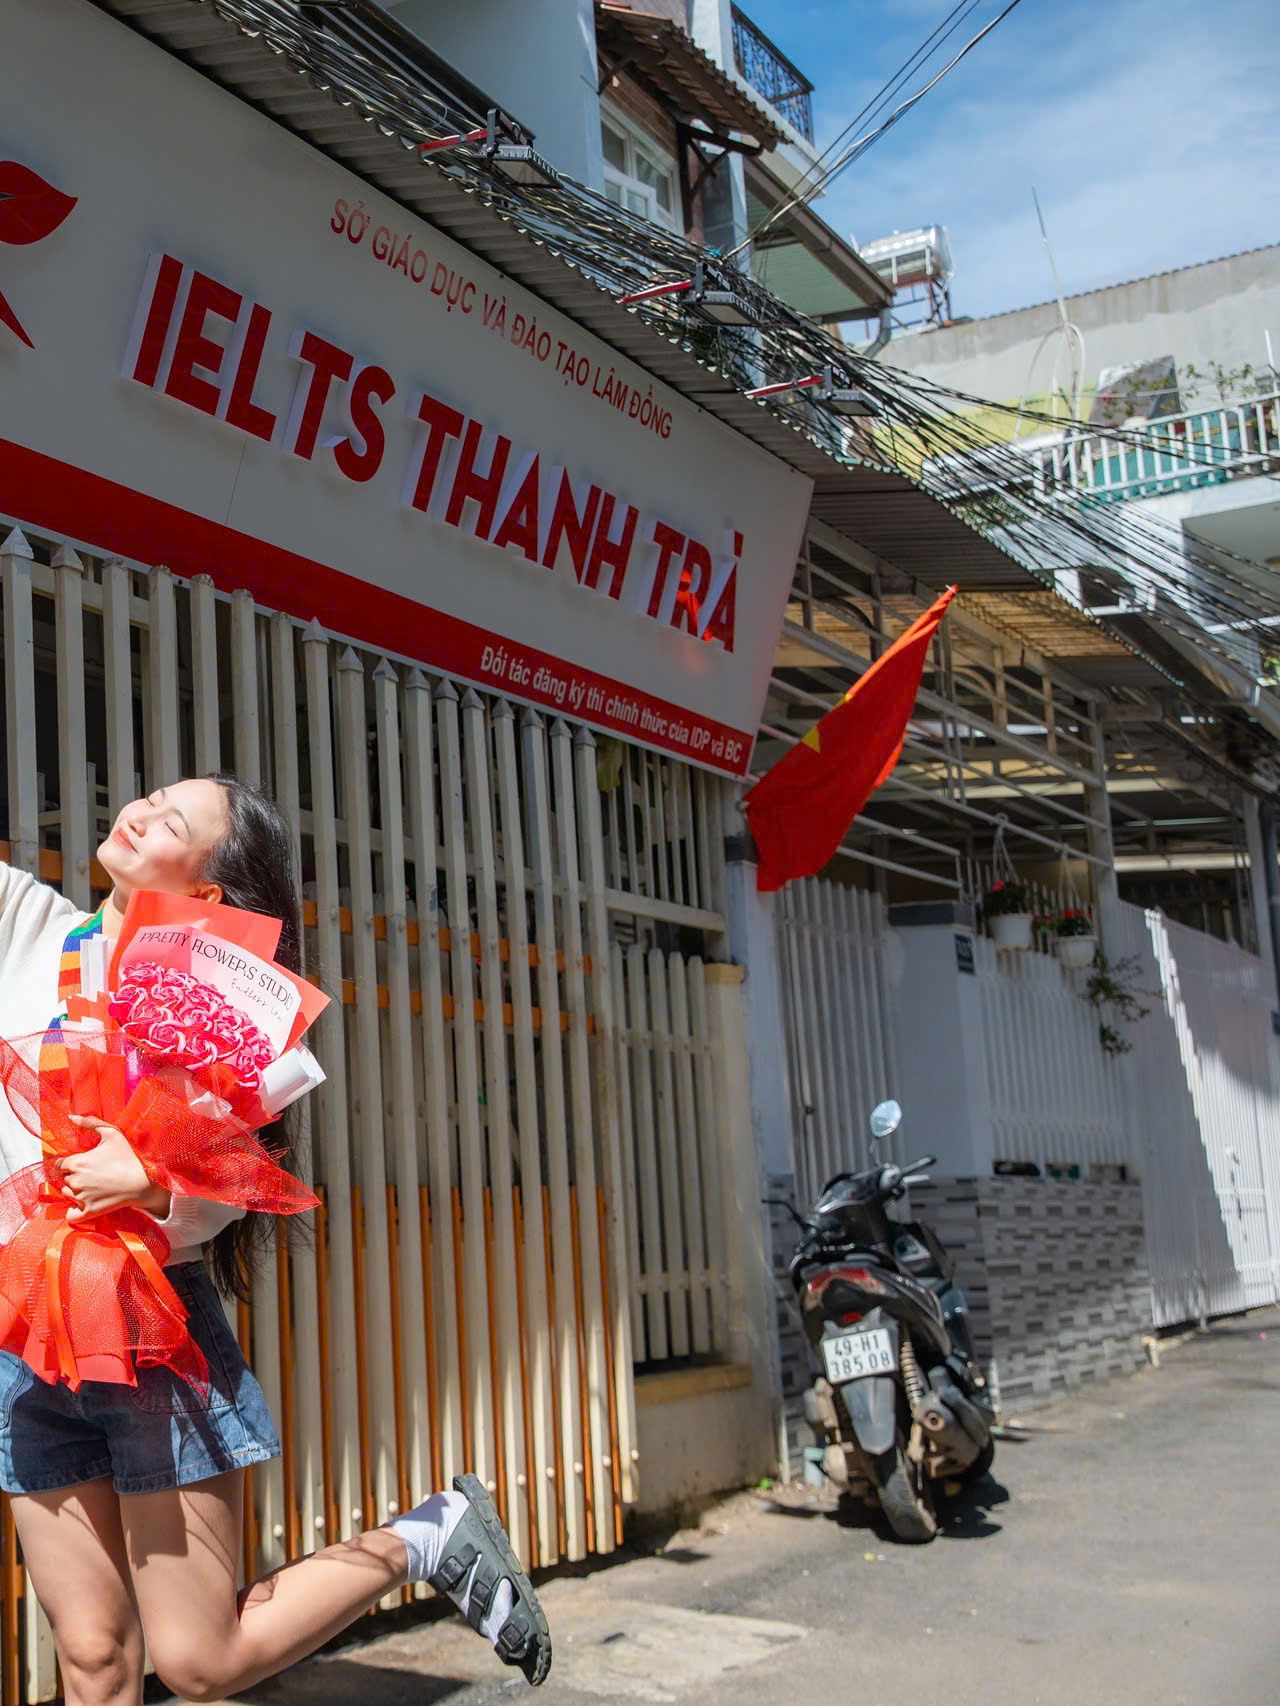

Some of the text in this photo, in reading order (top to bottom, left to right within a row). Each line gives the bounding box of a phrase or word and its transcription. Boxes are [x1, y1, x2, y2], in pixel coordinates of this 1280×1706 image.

[330, 198, 673, 440] SỞ GIÁO DỤC VÀ ĐÀO TẠO LÂM ĐỒNG
[131, 253, 744, 654] IELTS THANH TRÀ
[480, 645, 743, 764] Đối tác đăng ký thi chính thức của IDP và BC
[139, 931, 191, 946] PRETTY
[191, 938, 258, 981] FLOWERS
